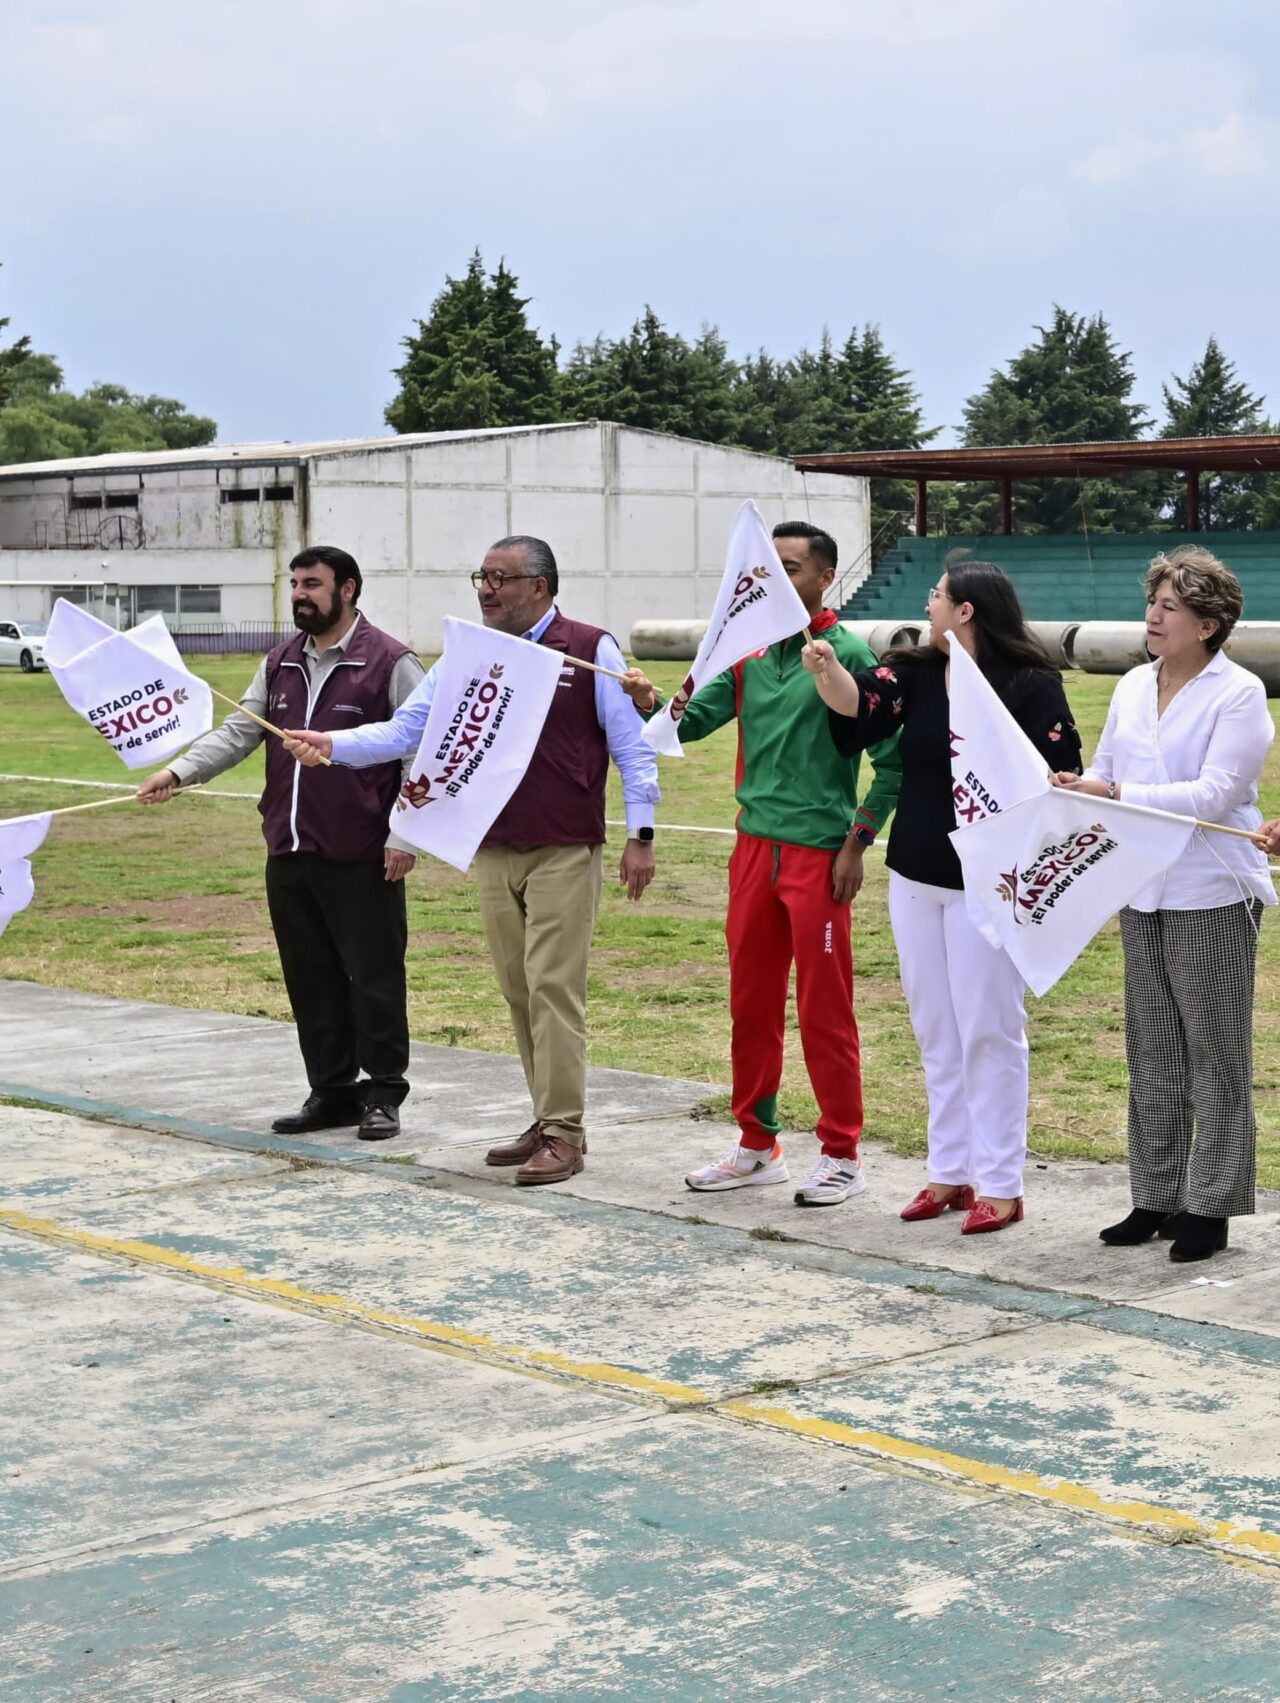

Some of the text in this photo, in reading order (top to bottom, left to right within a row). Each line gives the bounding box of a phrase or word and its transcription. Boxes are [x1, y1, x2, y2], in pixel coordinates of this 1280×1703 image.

[729, 586, 767, 618] servir!
[88, 678, 165, 722] ESTADO DE
[94, 696, 173, 740] ÉXICO
[435, 678, 481, 761] ESTADO DE
[126, 736, 143, 749] de
[144, 714, 181, 742] servir!
[445, 686, 514, 798] ¡El poder de servir!
[965, 769, 1003, 814] ESTAD
[1020, 845, 1064, 883] ESTADO
[1031, 838, 1118, 925] ¡El poder de servir!
